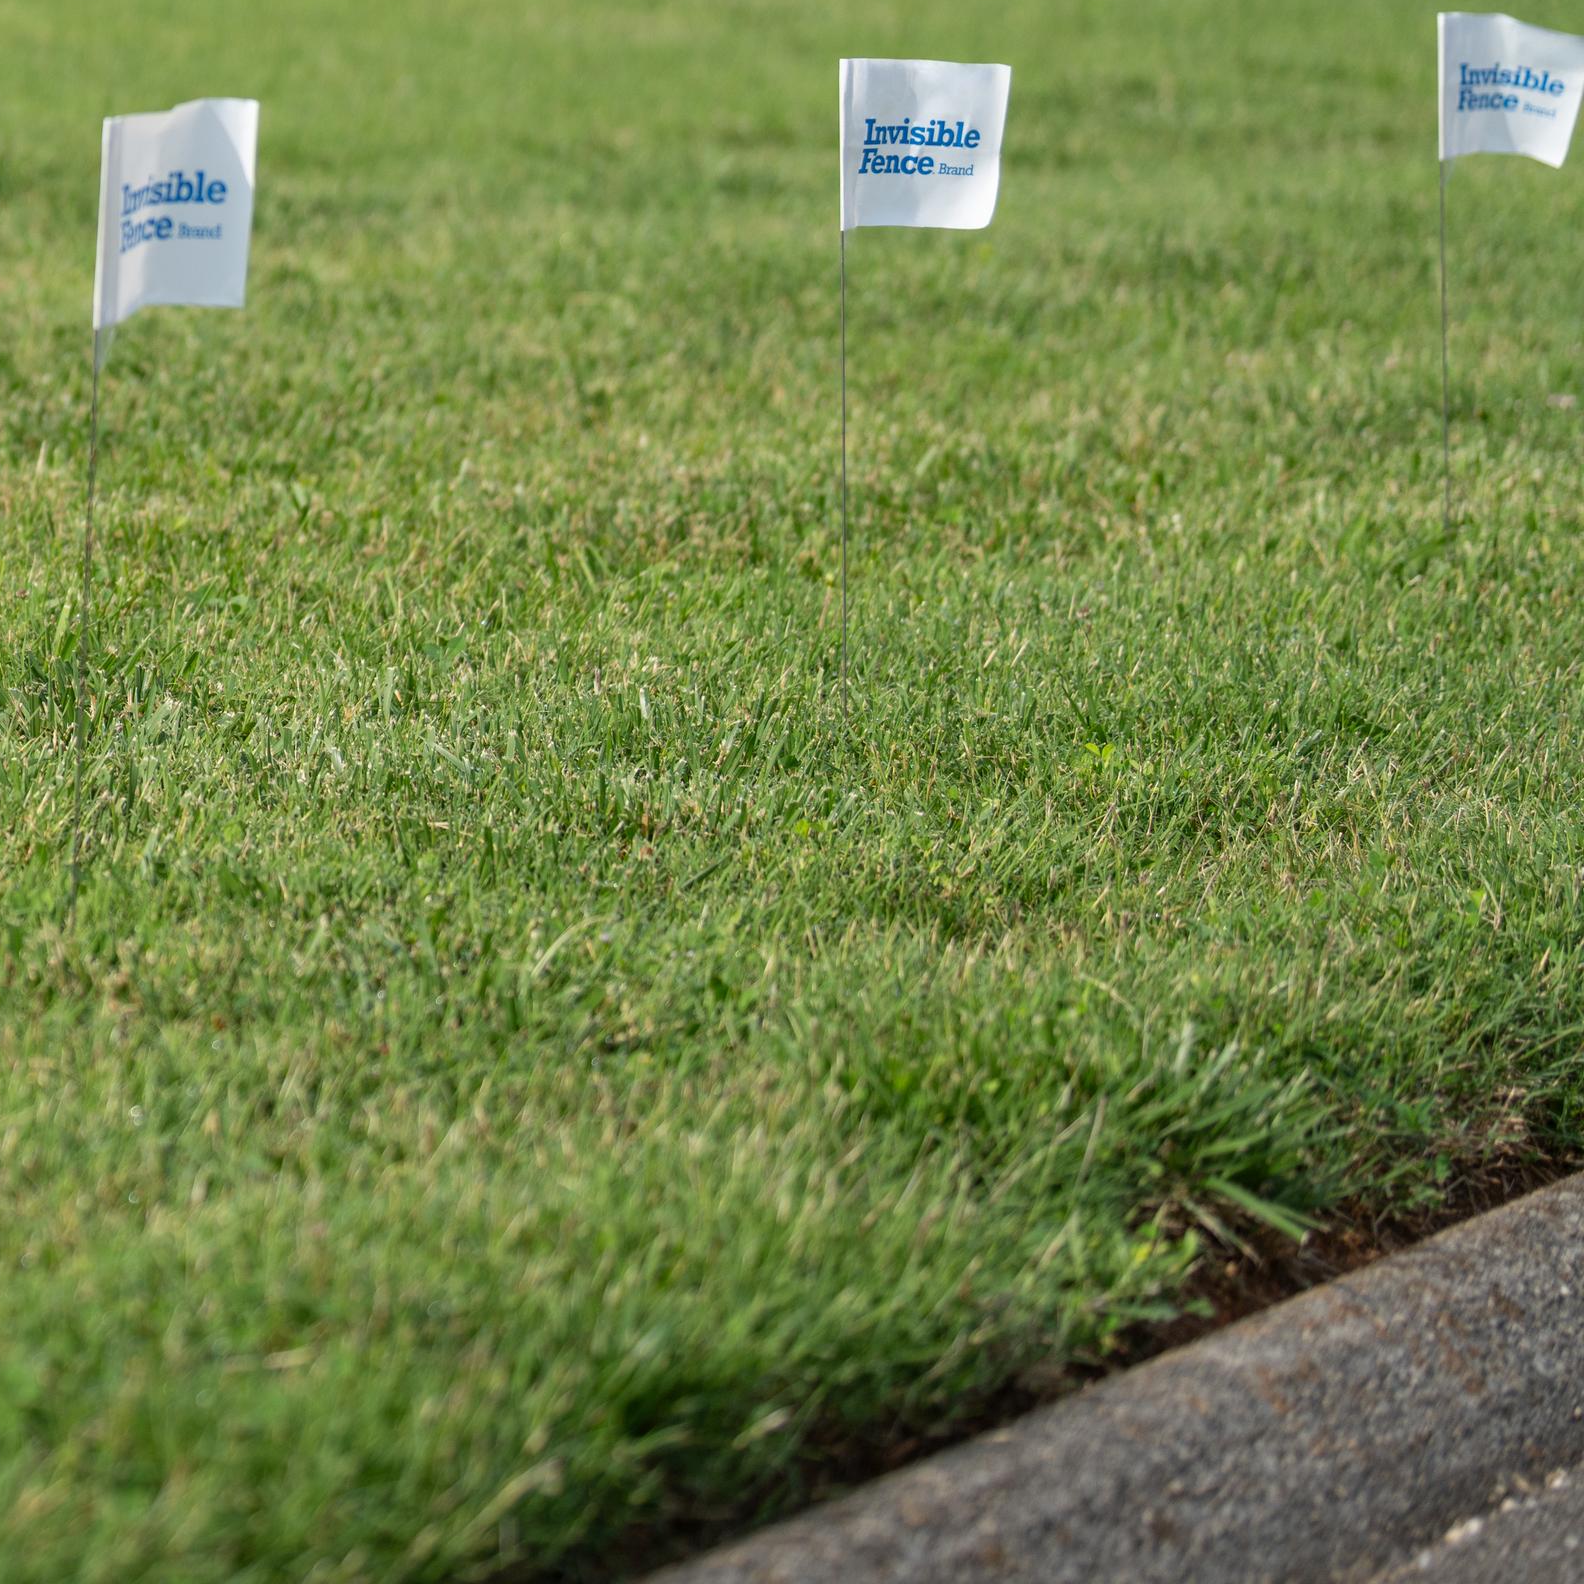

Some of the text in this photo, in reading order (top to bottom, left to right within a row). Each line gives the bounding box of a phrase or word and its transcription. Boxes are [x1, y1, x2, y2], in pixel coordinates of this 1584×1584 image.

[1458, 61, 1565, 97] Invisible
[1457, 87, 1519, 113] Fence
[864, 118, 980, 149] Invisible
[858, 148, 974, 176] Fence Brand
[122, 170, 228, 216] Invisible
[178, 222, 223, 241] Brand
